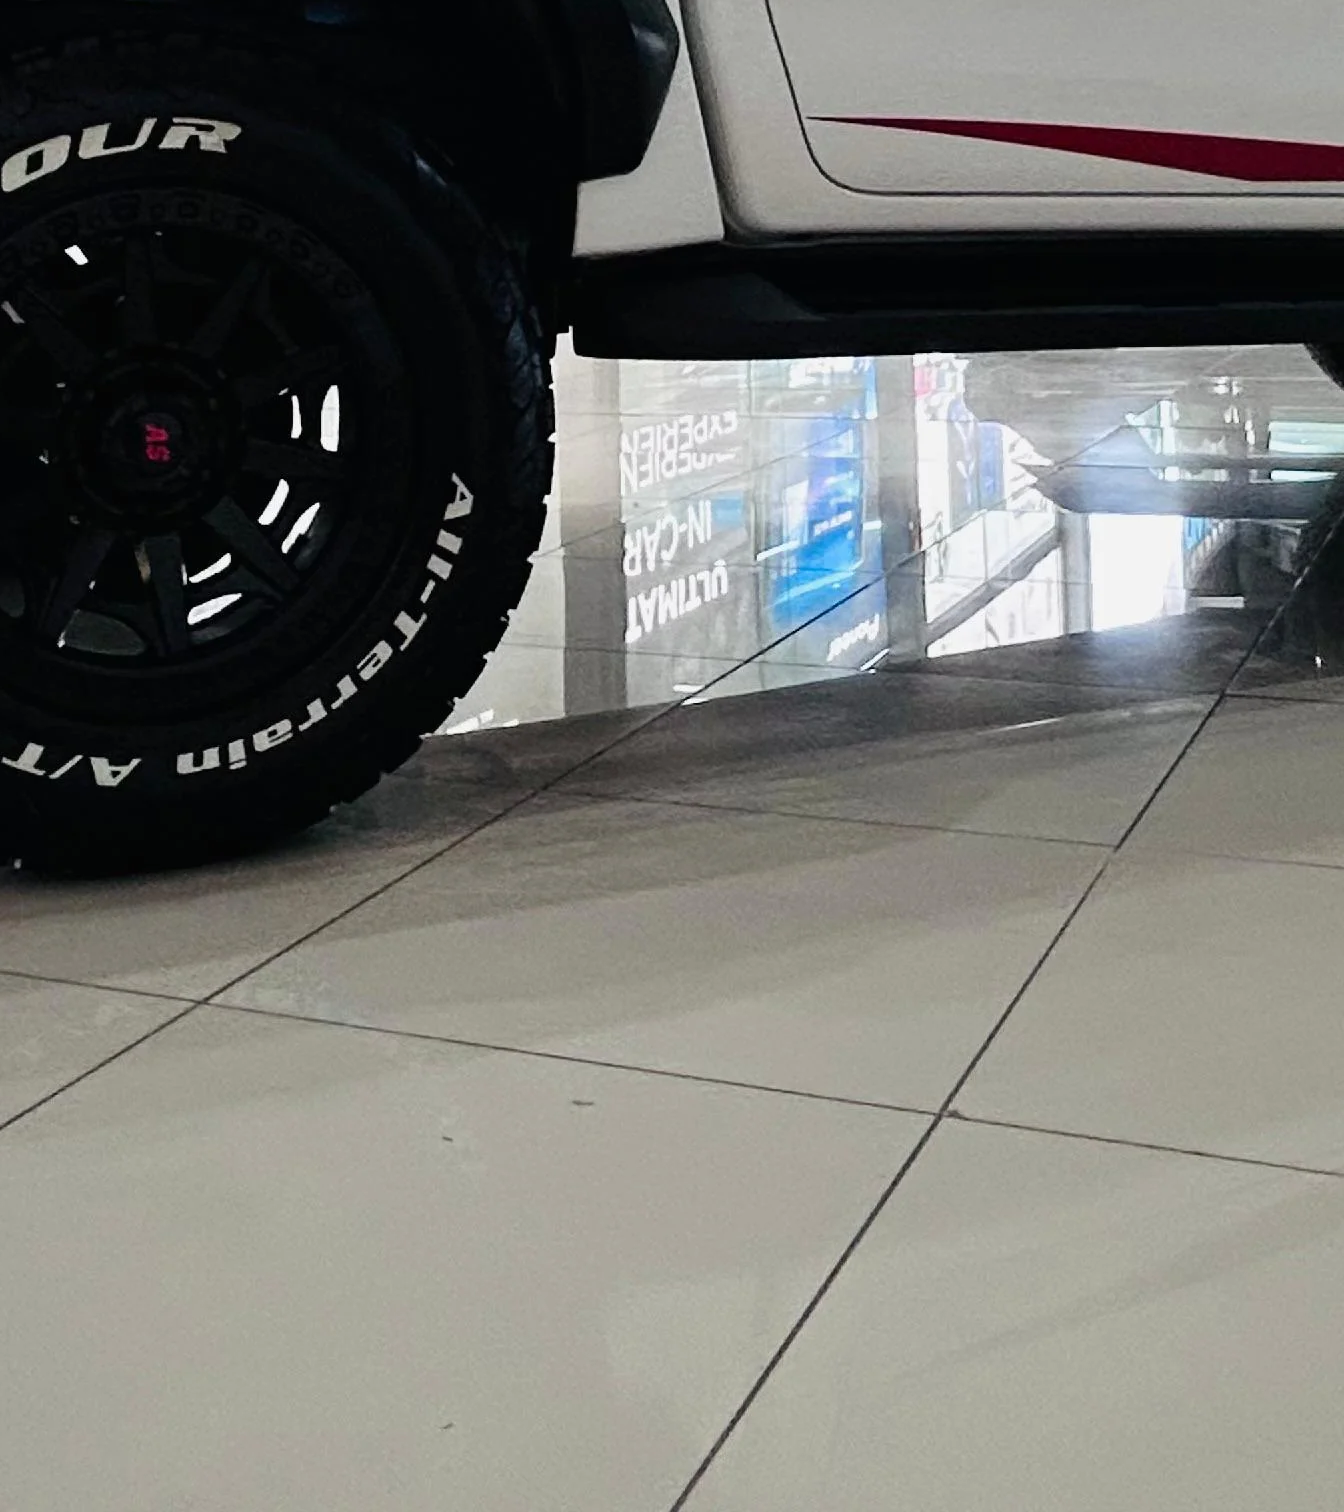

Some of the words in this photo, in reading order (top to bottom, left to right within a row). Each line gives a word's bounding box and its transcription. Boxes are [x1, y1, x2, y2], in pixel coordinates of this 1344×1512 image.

[623, 500, 712, 577] IN-CAR
[175, 472, 475, 777] All-Terrain
[1, 739, 141, 788] A/T
